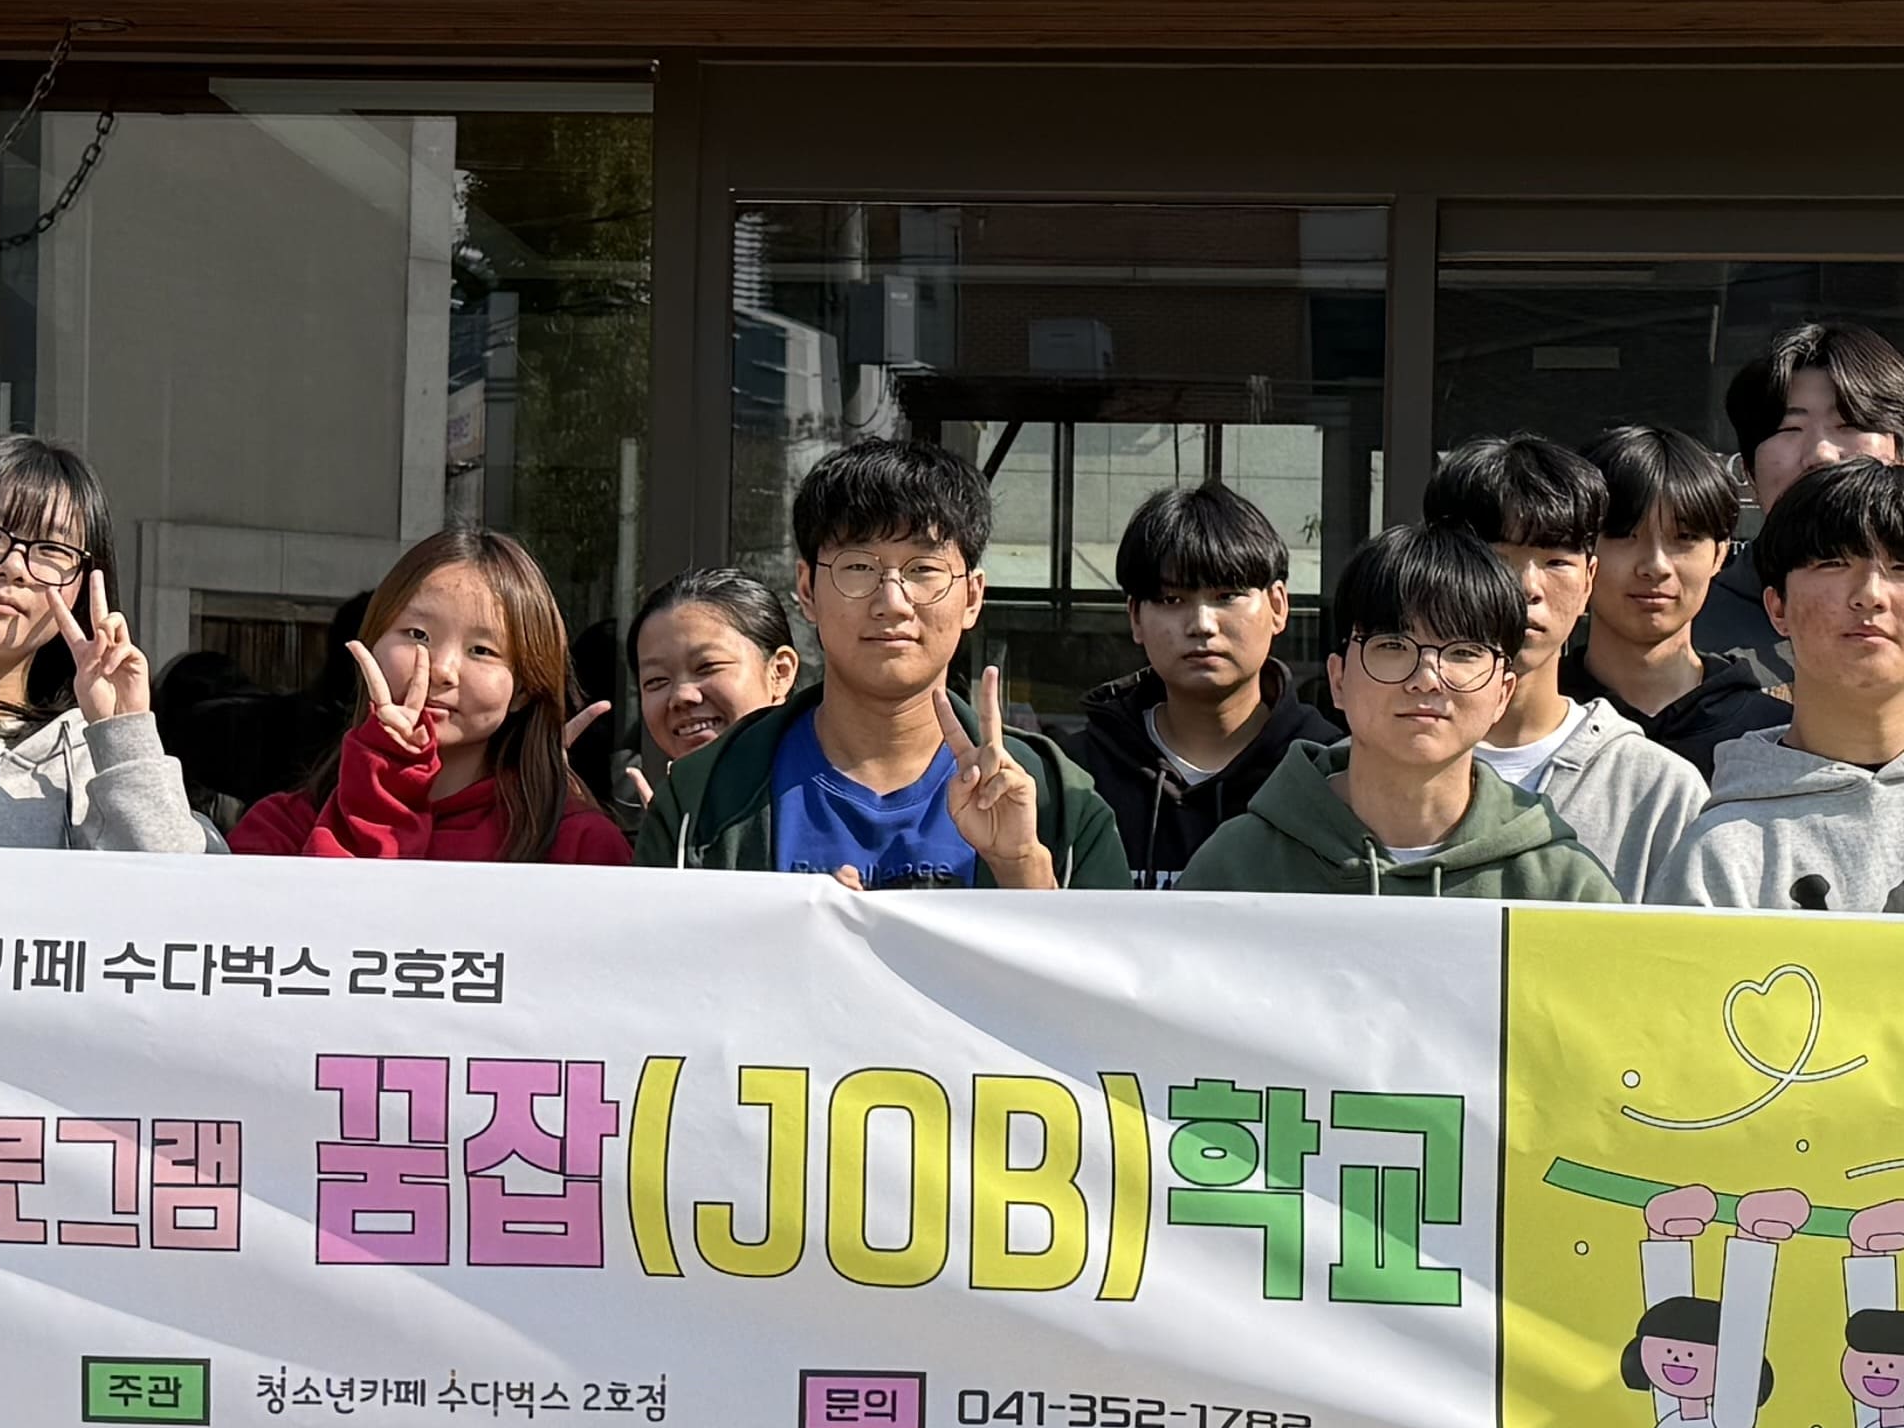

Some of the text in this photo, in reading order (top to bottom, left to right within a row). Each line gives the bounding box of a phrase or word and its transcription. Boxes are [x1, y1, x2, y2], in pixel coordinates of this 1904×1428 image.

[102, 941, 331, 997] 수다벅스
[348, 948, 505, 1004] 2호점
[315, 1054, 1466, 1307] 꿈잡(JOB)학교
[108, 1373, 181, 1410] 주관
[256, 1367, 668, 1422] 청소년카페 수다벅스 2호점
[822, 1385, 899, 1426] 문의
